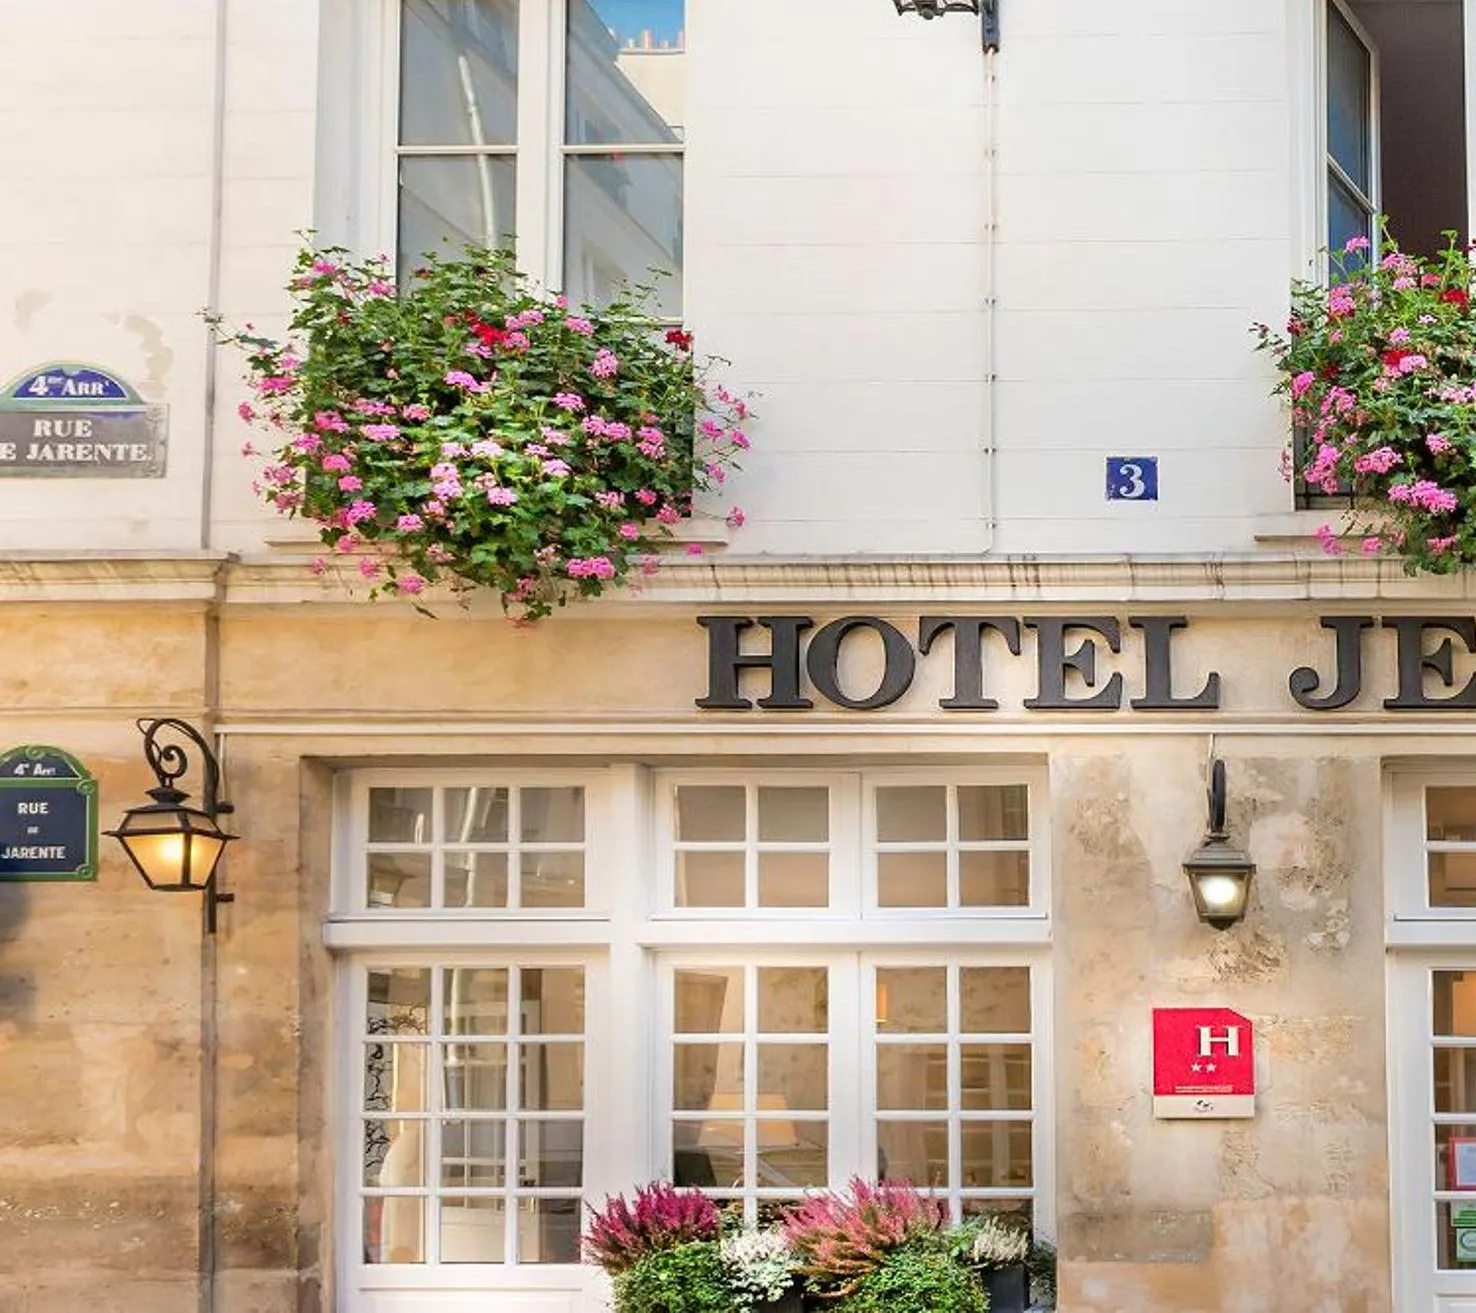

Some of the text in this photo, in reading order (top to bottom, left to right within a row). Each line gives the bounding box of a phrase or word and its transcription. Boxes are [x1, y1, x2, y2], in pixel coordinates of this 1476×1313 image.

[33, 419, 92, 437] RUE
[0, 442, 17, 461] E
[1119, 463, 1146, 498] 3
[694, 615, 1220, 711] HOTEL
[17, 802, 49, 814] RUE
[0, 846, 66, 860] JARENTE
[1196, 1025, 1241, 1058] H
